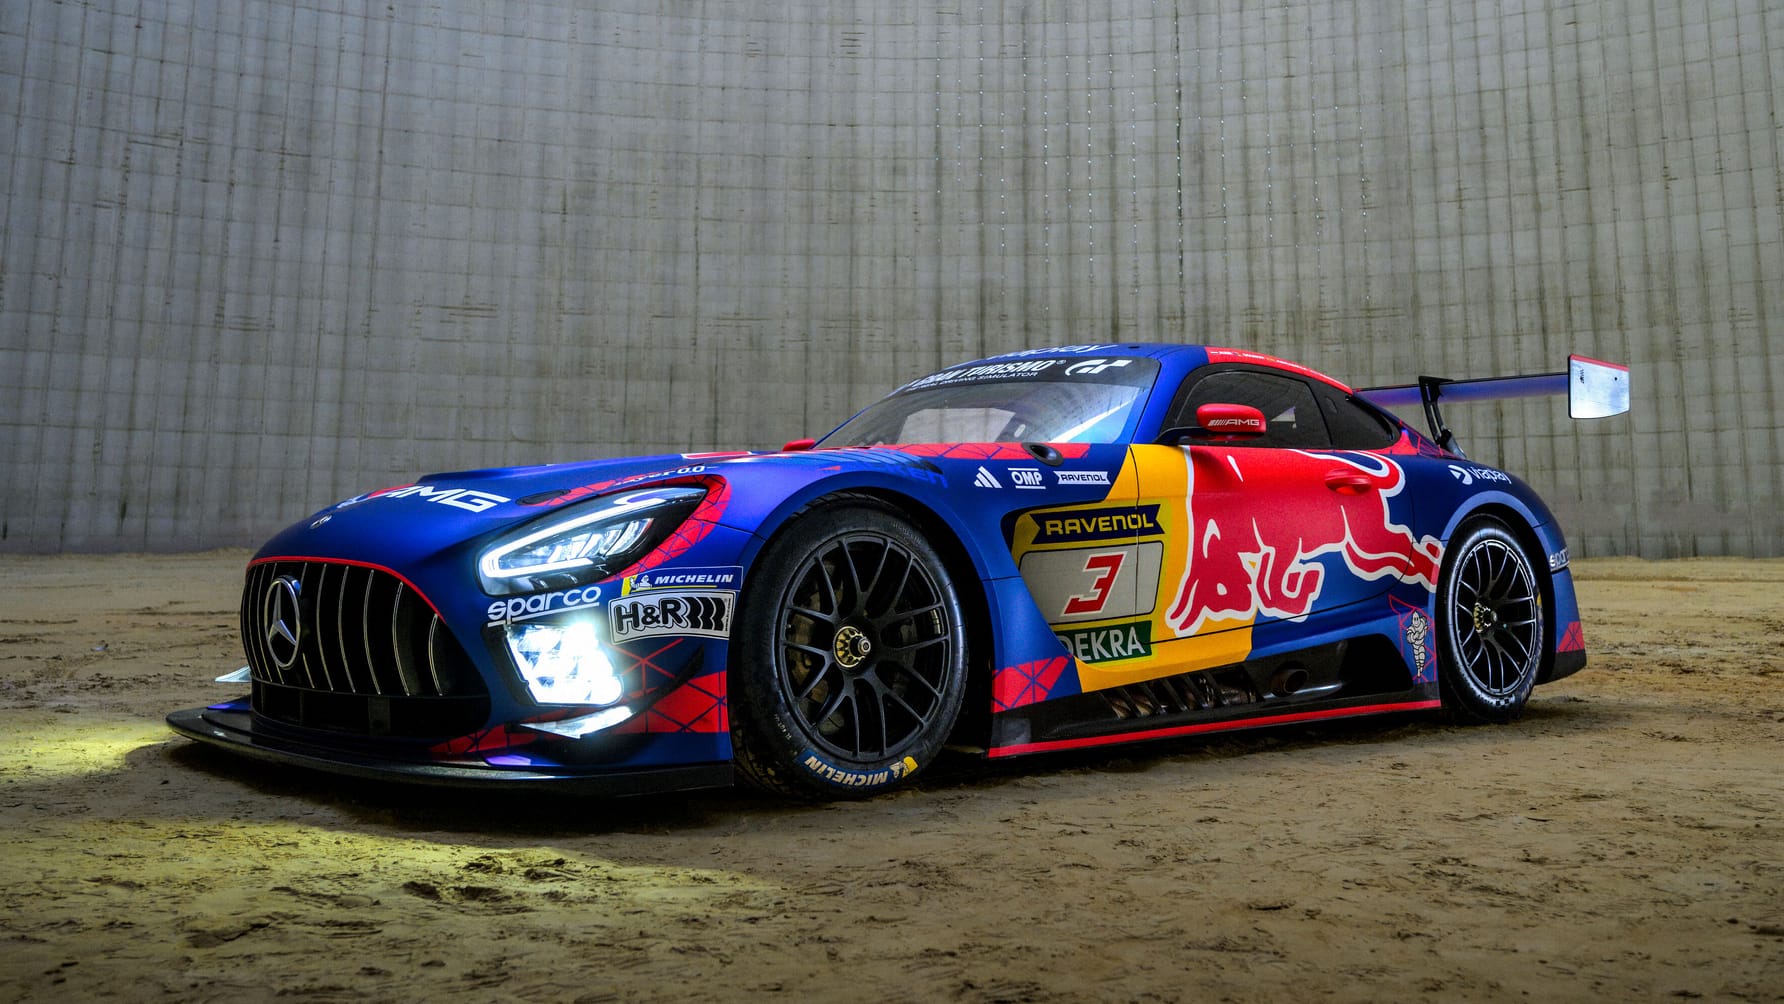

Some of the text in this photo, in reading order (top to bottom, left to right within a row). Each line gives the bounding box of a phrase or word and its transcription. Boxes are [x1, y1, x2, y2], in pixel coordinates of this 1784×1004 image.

[977, 371, 1039, 381] SIMULATOR
[1010, 470, 1043, 486] OMP
[1060, 473, 1107, 482] RAVENOL
[386, 485, 512, 513] AMG
[1045, 513, 1155, 536] RAVENOL
[654, 573, 734, 585] MICHELIN
[1060, 551, 1128, 617] 3
[487, 586, 602, 625] sparco
[614, 598, 687, 634] H&R
[804, 755, 889, 786] MICHELIN
